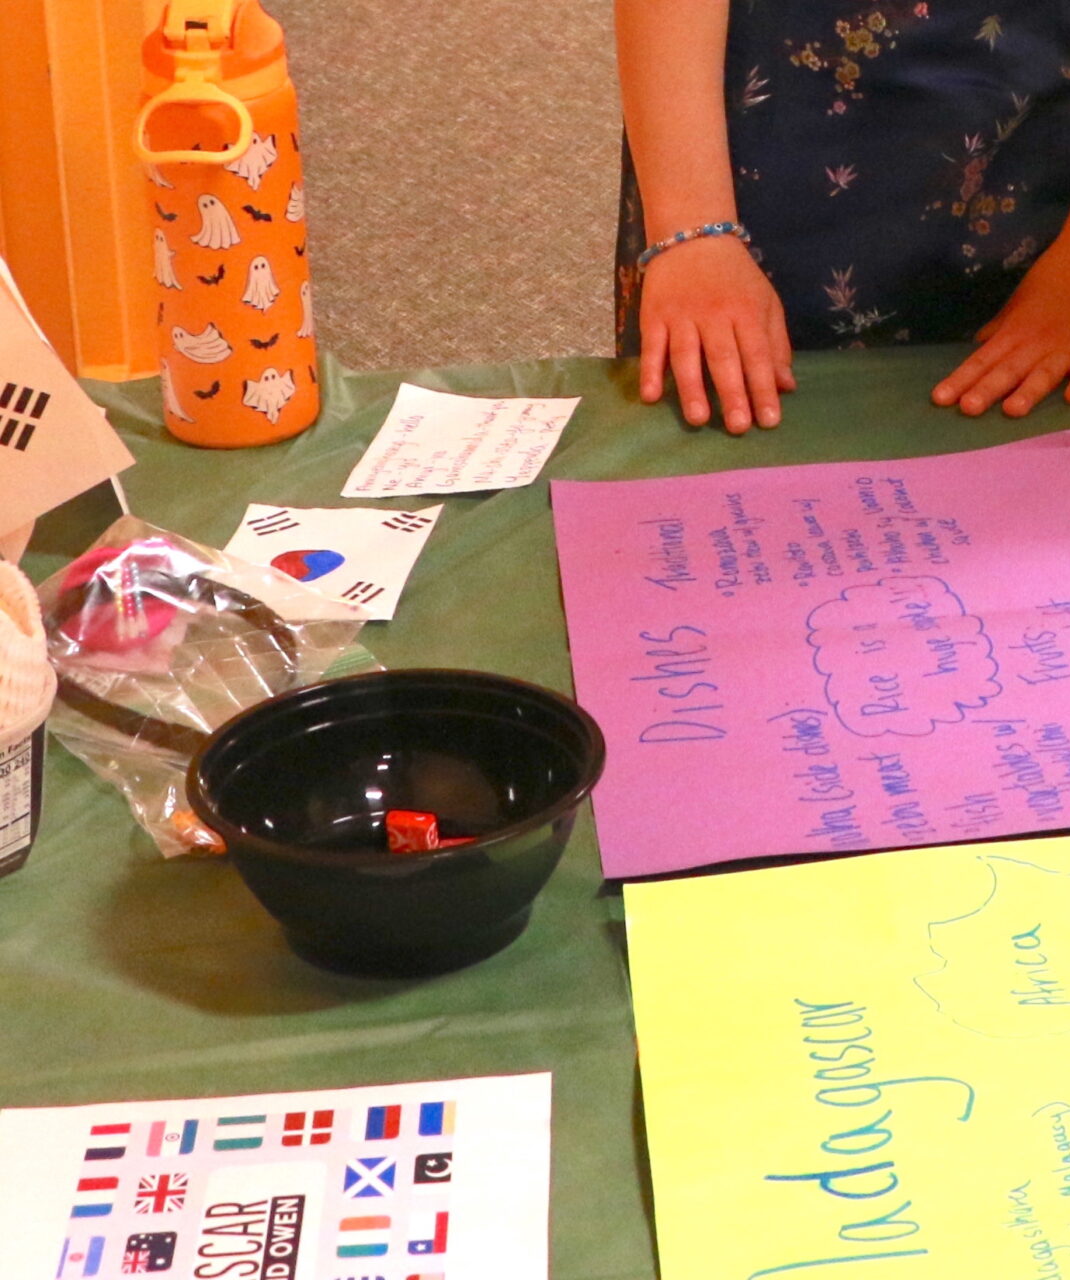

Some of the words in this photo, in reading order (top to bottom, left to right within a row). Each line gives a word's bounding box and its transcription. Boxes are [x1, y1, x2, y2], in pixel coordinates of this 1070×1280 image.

[855, 640, 886, 654] is
[922, 635, 977, 677] huge
[629, 625, 729, 743] Dishes
[860, 674, 909, 716] Rice
[858, 752, 916, 796] meat
[1010, 920, 1070, 1010] Africa
[193, 1200, 268, 1280] SCAR
[269, 1198, 299, 1257] OWEN
